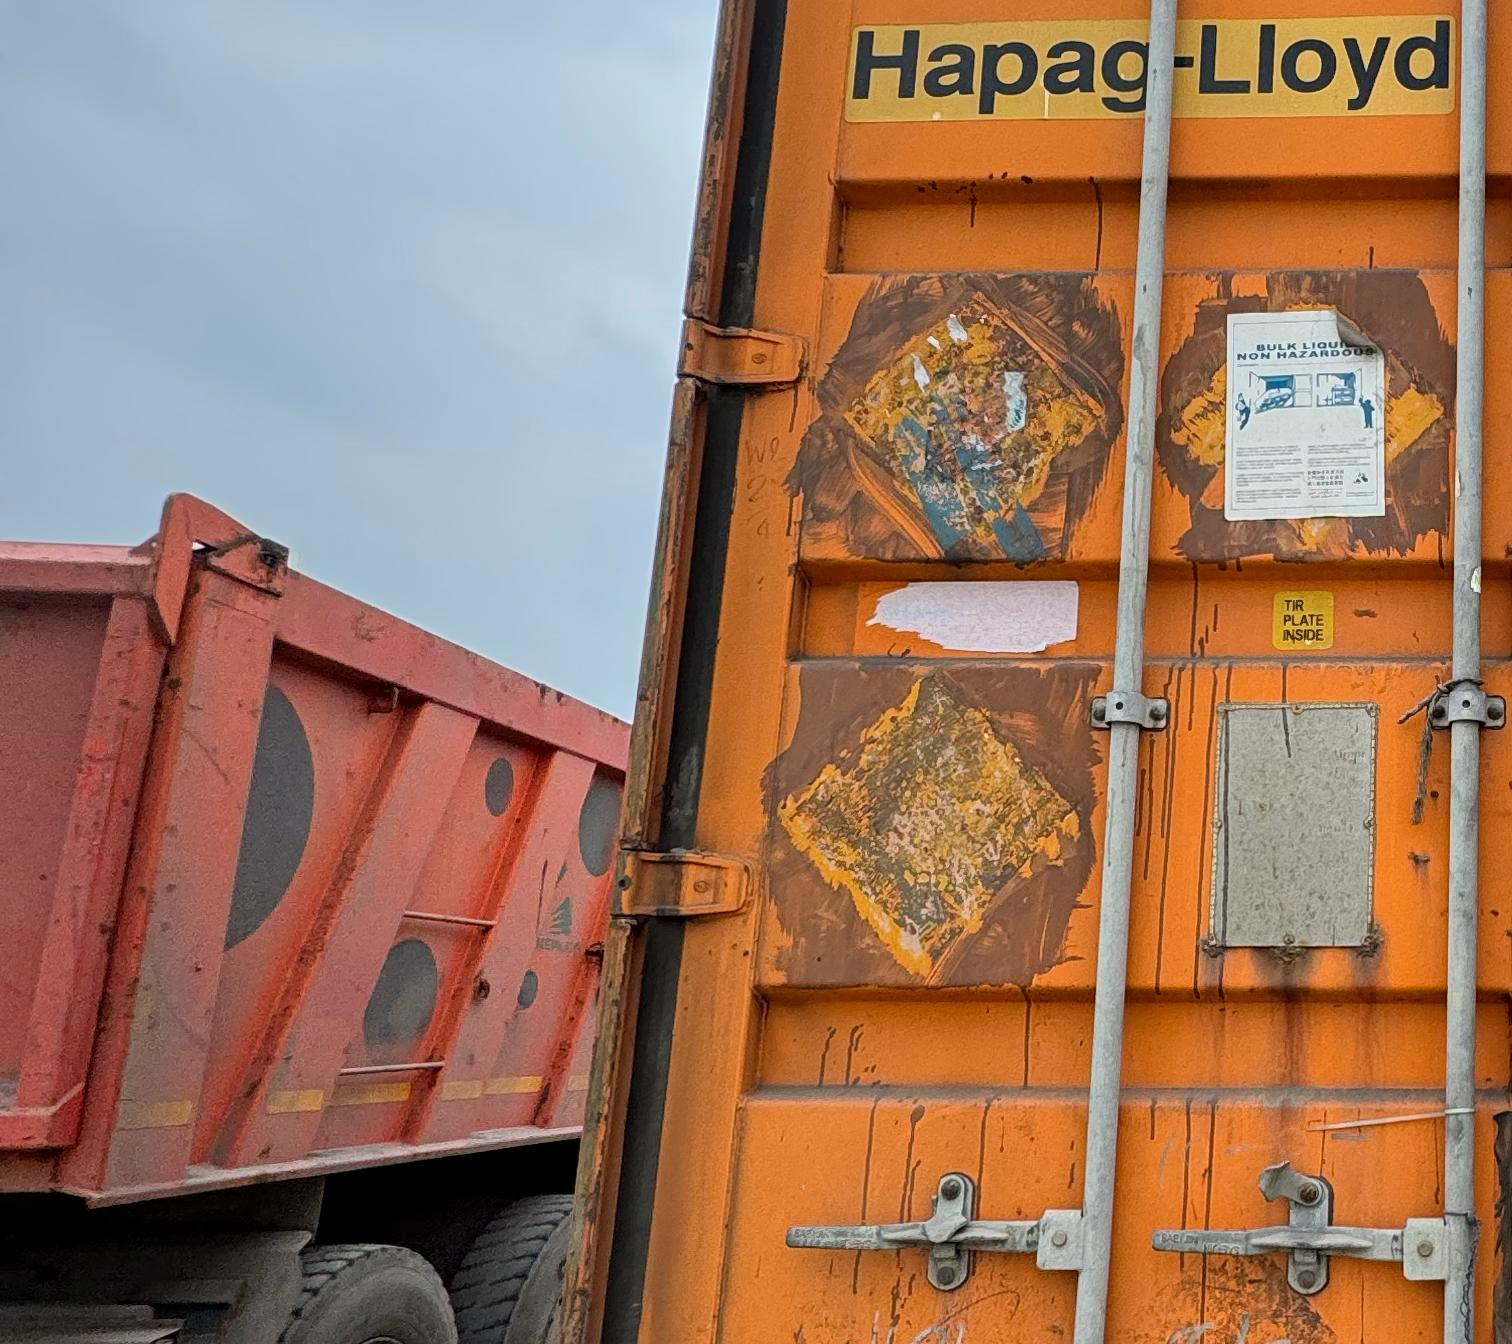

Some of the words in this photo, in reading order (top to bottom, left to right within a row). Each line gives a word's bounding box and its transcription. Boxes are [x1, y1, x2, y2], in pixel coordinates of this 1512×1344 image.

[852, 20, 1451, 115] Hapag-Lloyd
[1255, 342, 1297, 352] BULK
[1302, 340, 1351, 350] LIQUI
[1236, 352, 1271, 361] NON
[1276, 347, 1376, 359] HAZARDOUS
[1283, 599, 1305, 612] TIR
[1283, 613, 1325, 627] PLATE
[1282, 628, 1325, 643] INSIDE
